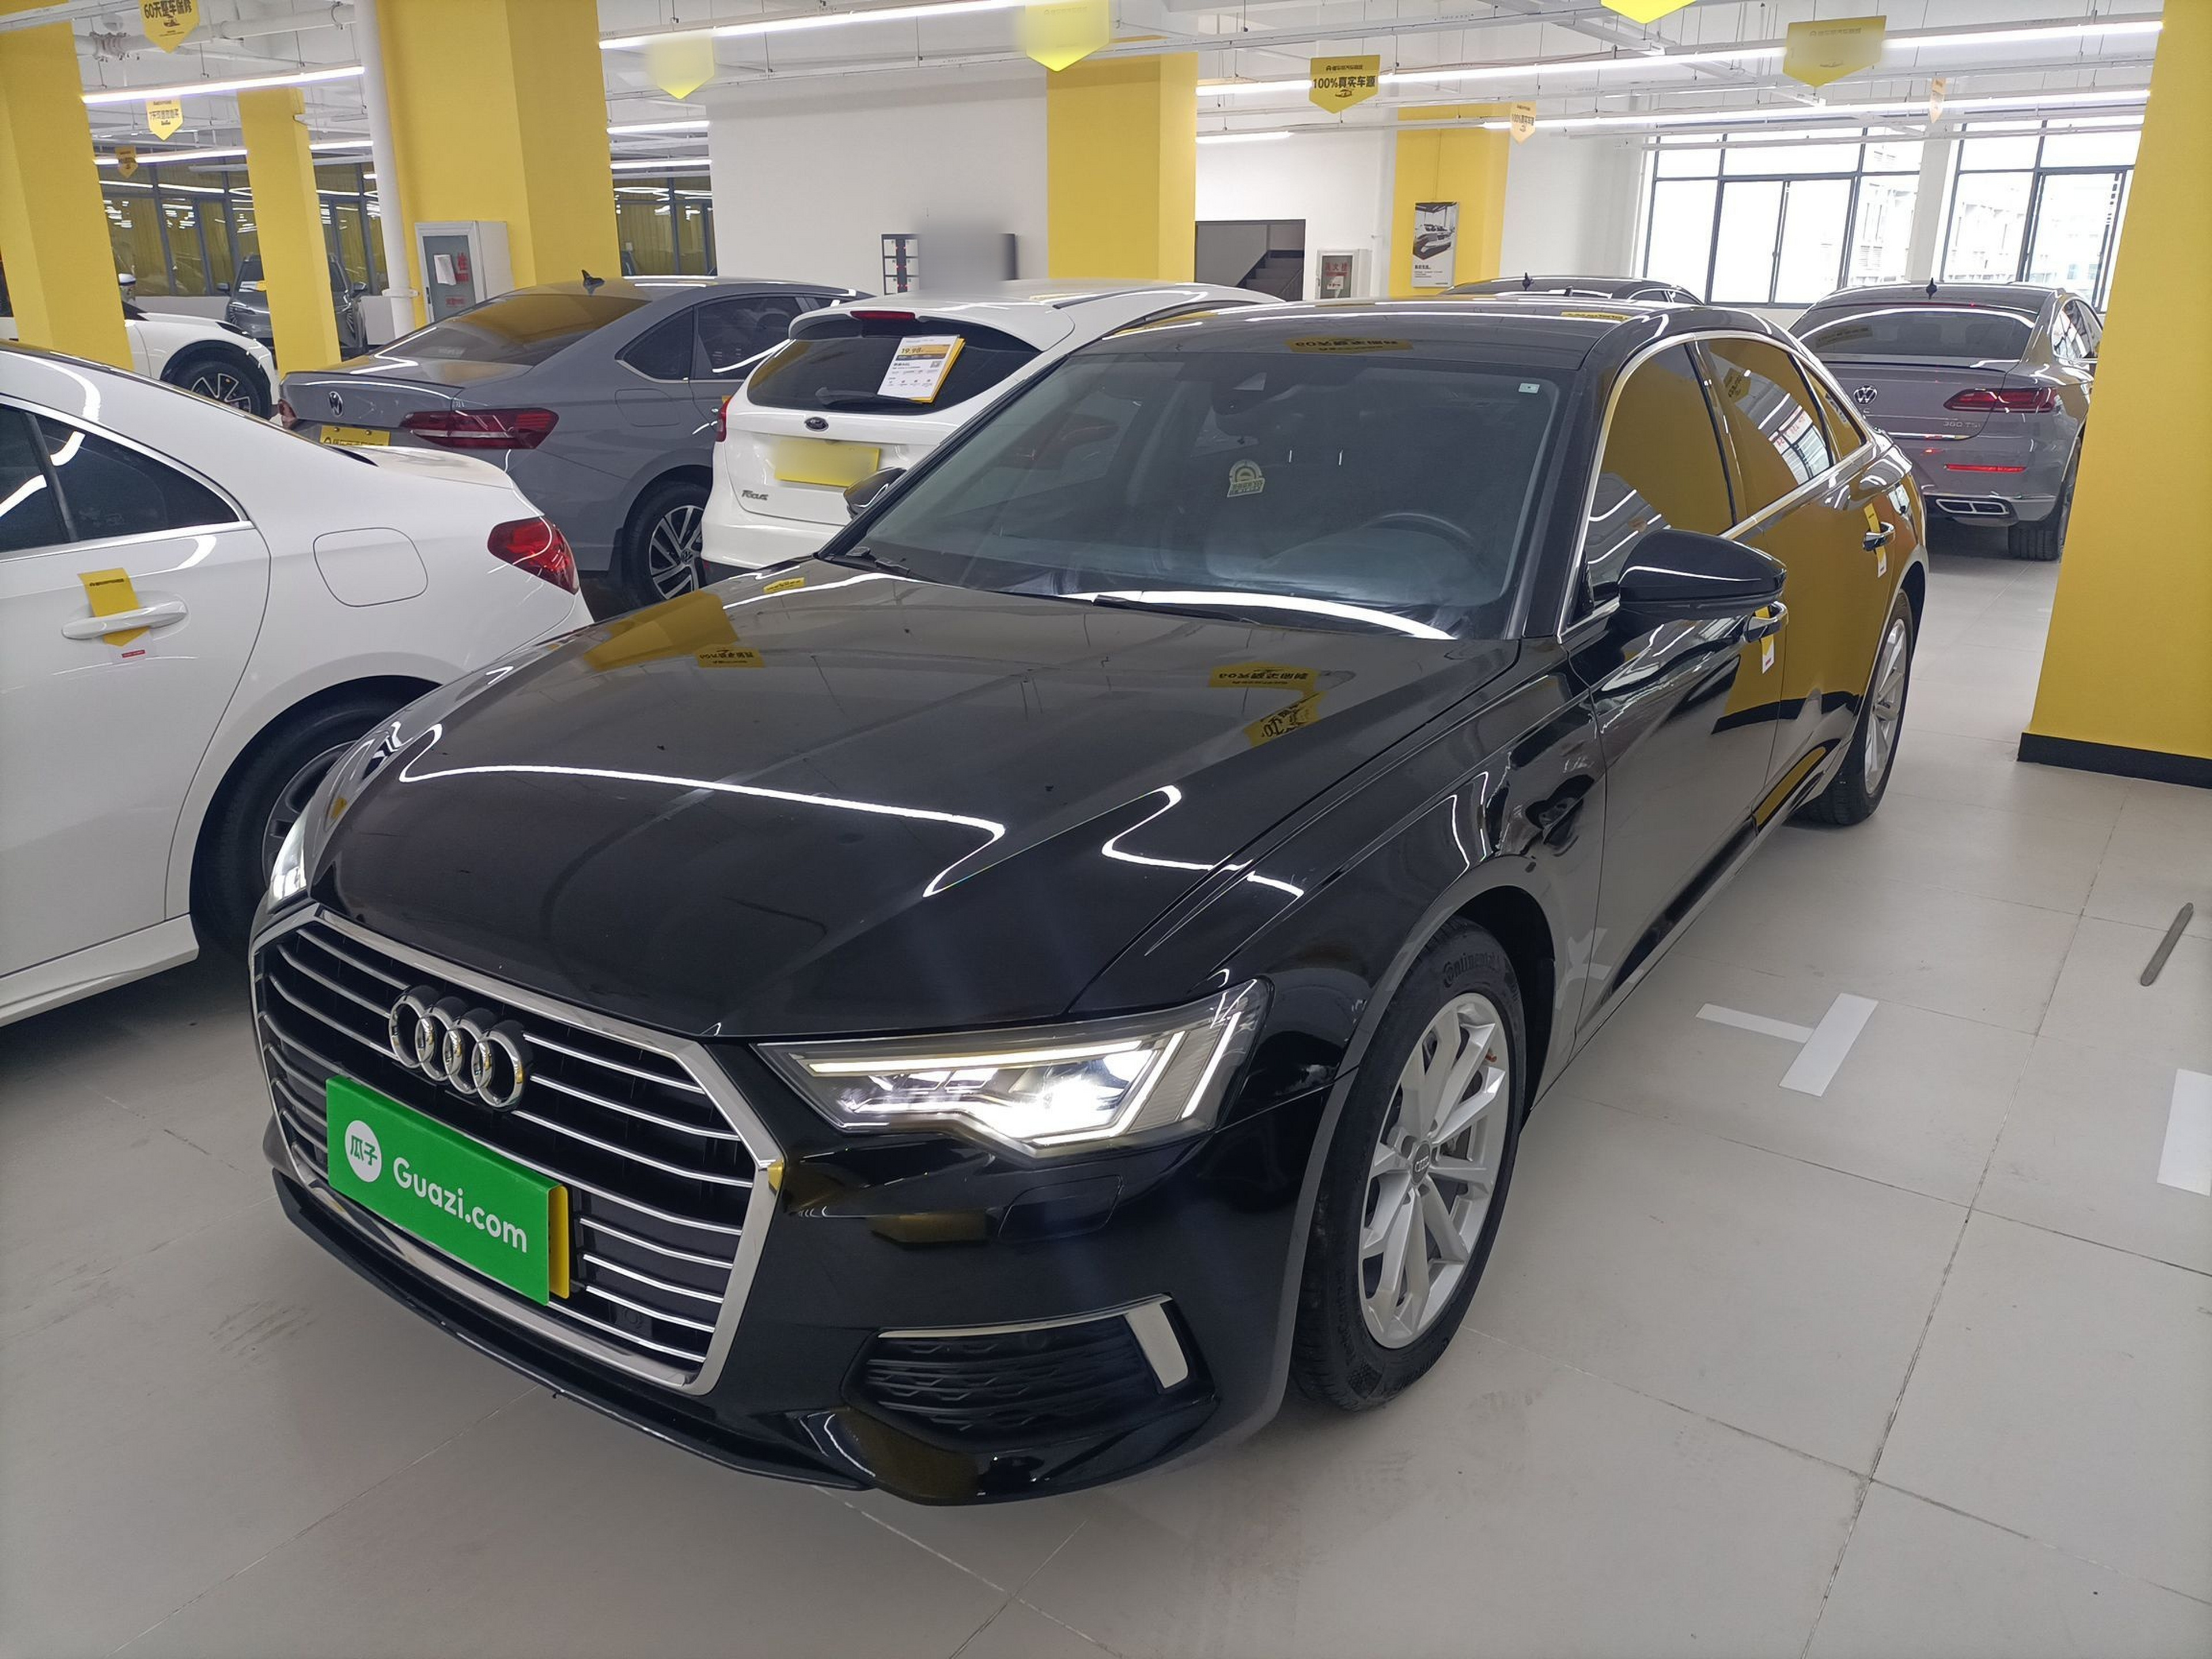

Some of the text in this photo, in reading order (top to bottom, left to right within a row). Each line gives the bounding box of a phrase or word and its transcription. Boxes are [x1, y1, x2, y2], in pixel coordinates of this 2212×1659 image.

[1313, 75, 1376, 89] 100%真实车源
[351, 1135, 378, 1166] 瓜子
[393, 1157, 527, 1253] Guazi.com
